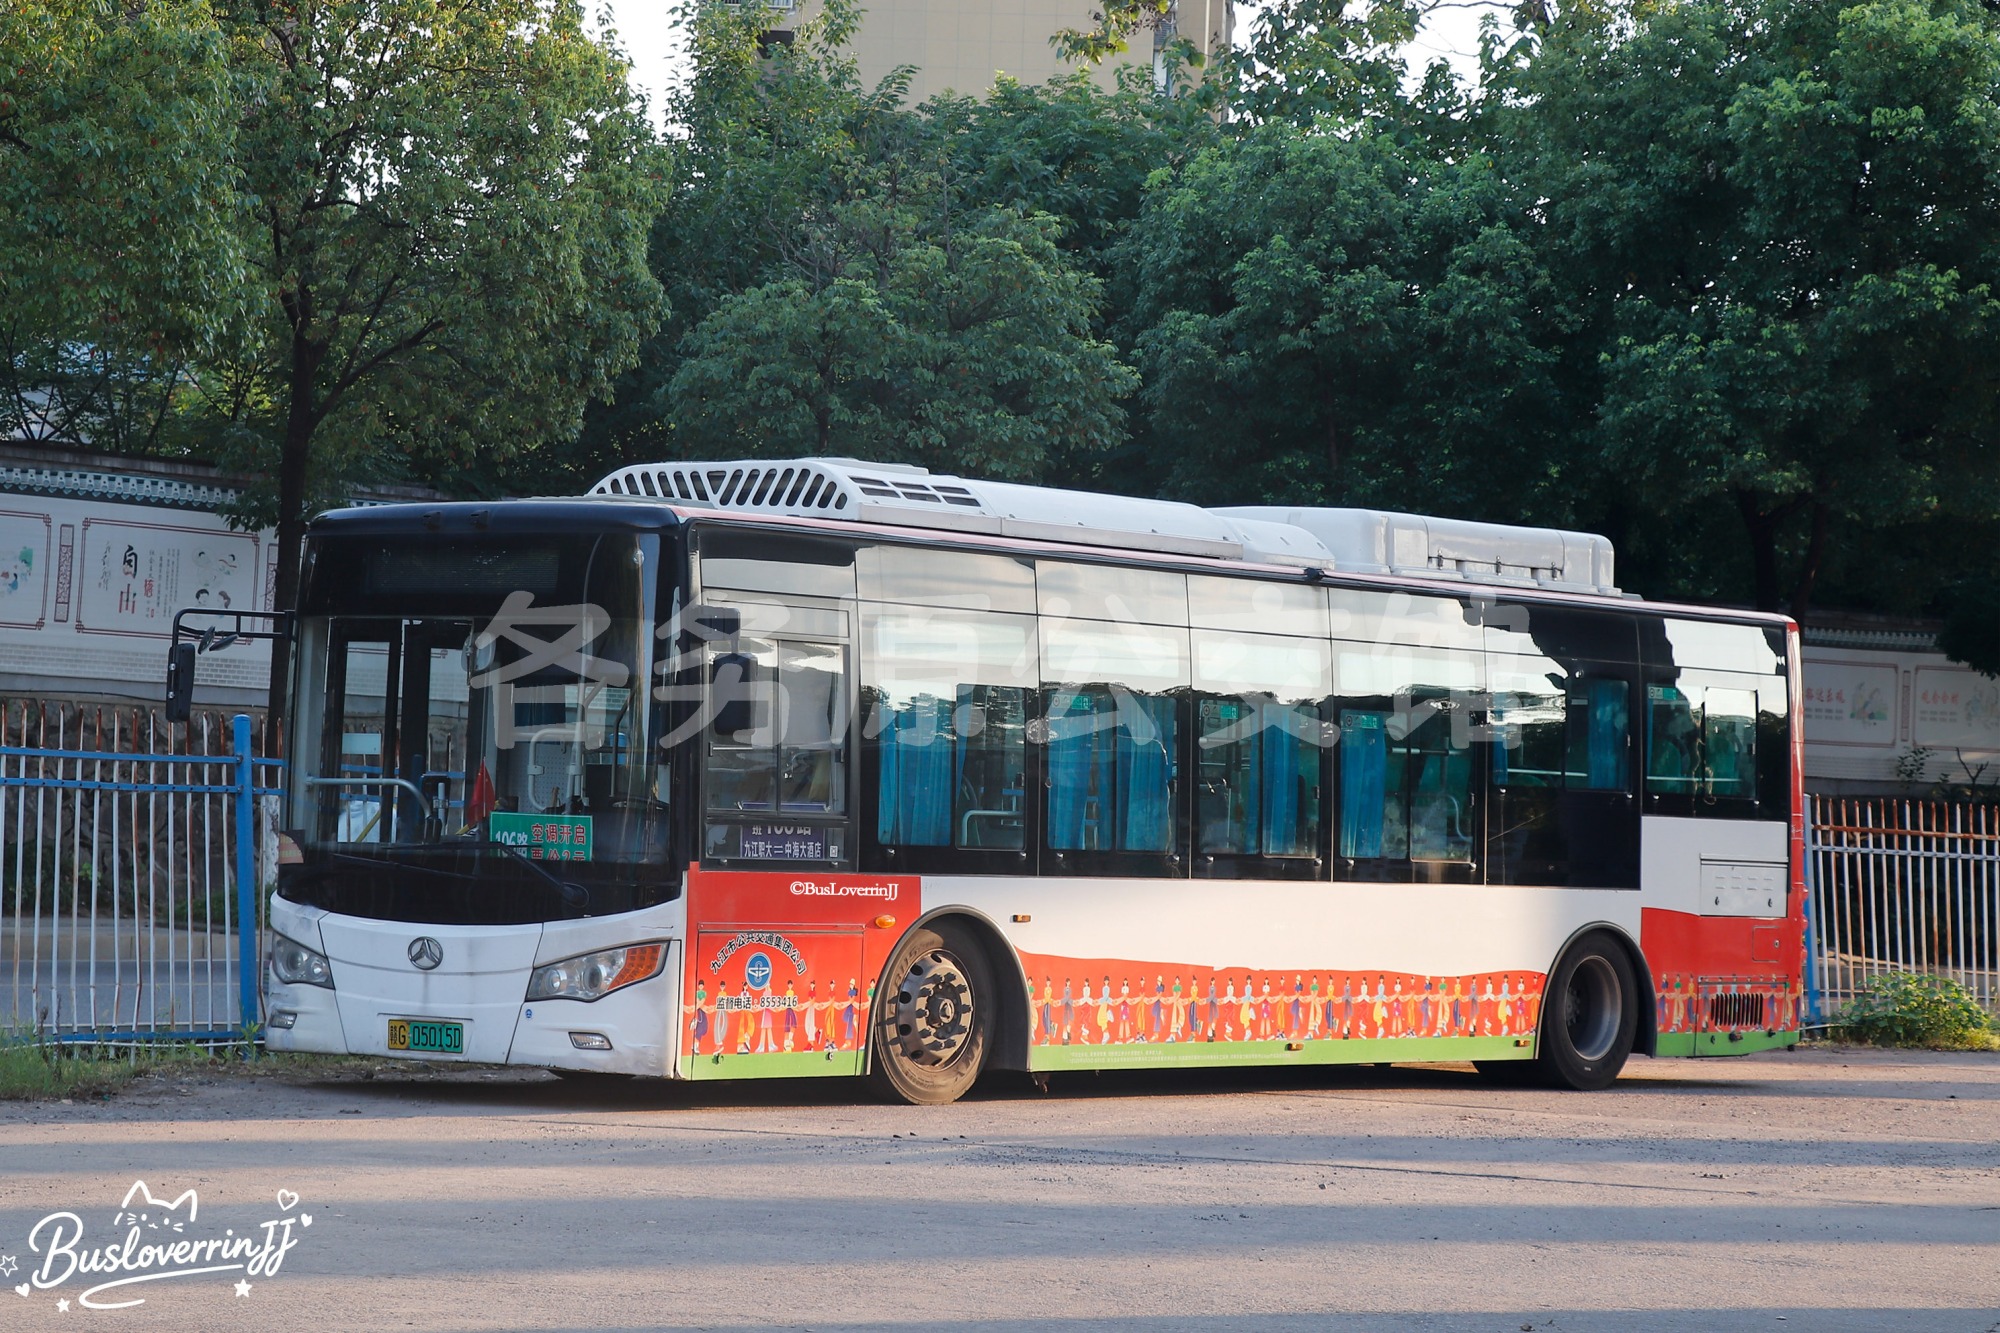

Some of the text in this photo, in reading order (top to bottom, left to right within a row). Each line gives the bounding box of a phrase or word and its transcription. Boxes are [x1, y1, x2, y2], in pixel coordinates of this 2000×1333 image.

[531, 822, 587, 844] 空调开启
[709, 931, 807, 976] 九江市公共交通集团公司
